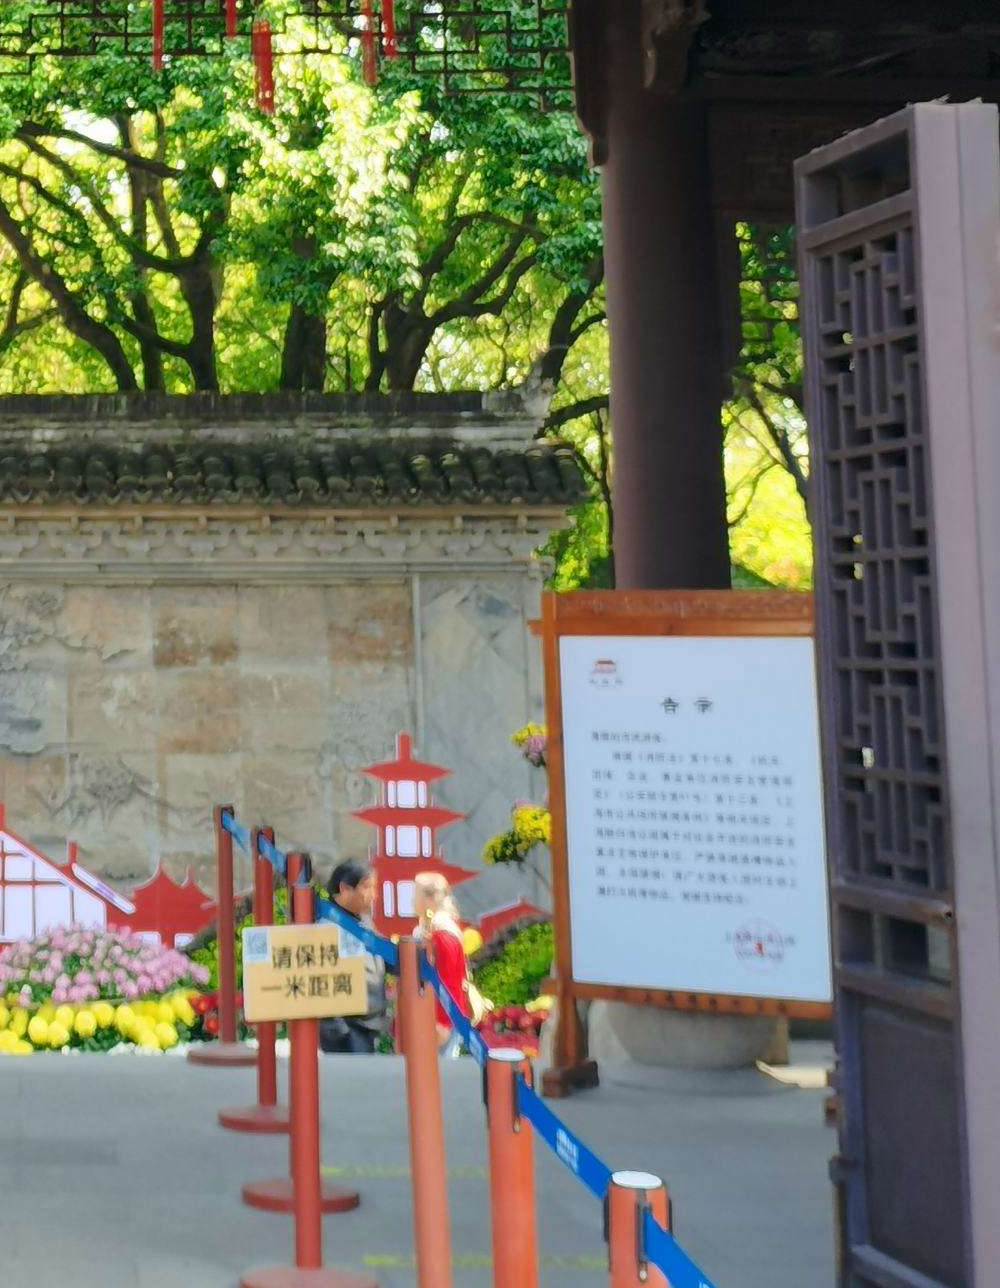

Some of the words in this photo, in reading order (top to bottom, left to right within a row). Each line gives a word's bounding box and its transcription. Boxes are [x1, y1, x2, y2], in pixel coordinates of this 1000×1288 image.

[272, 942, 339, 970] 请保持
[260, 971, 353, 1000] 一米距离
